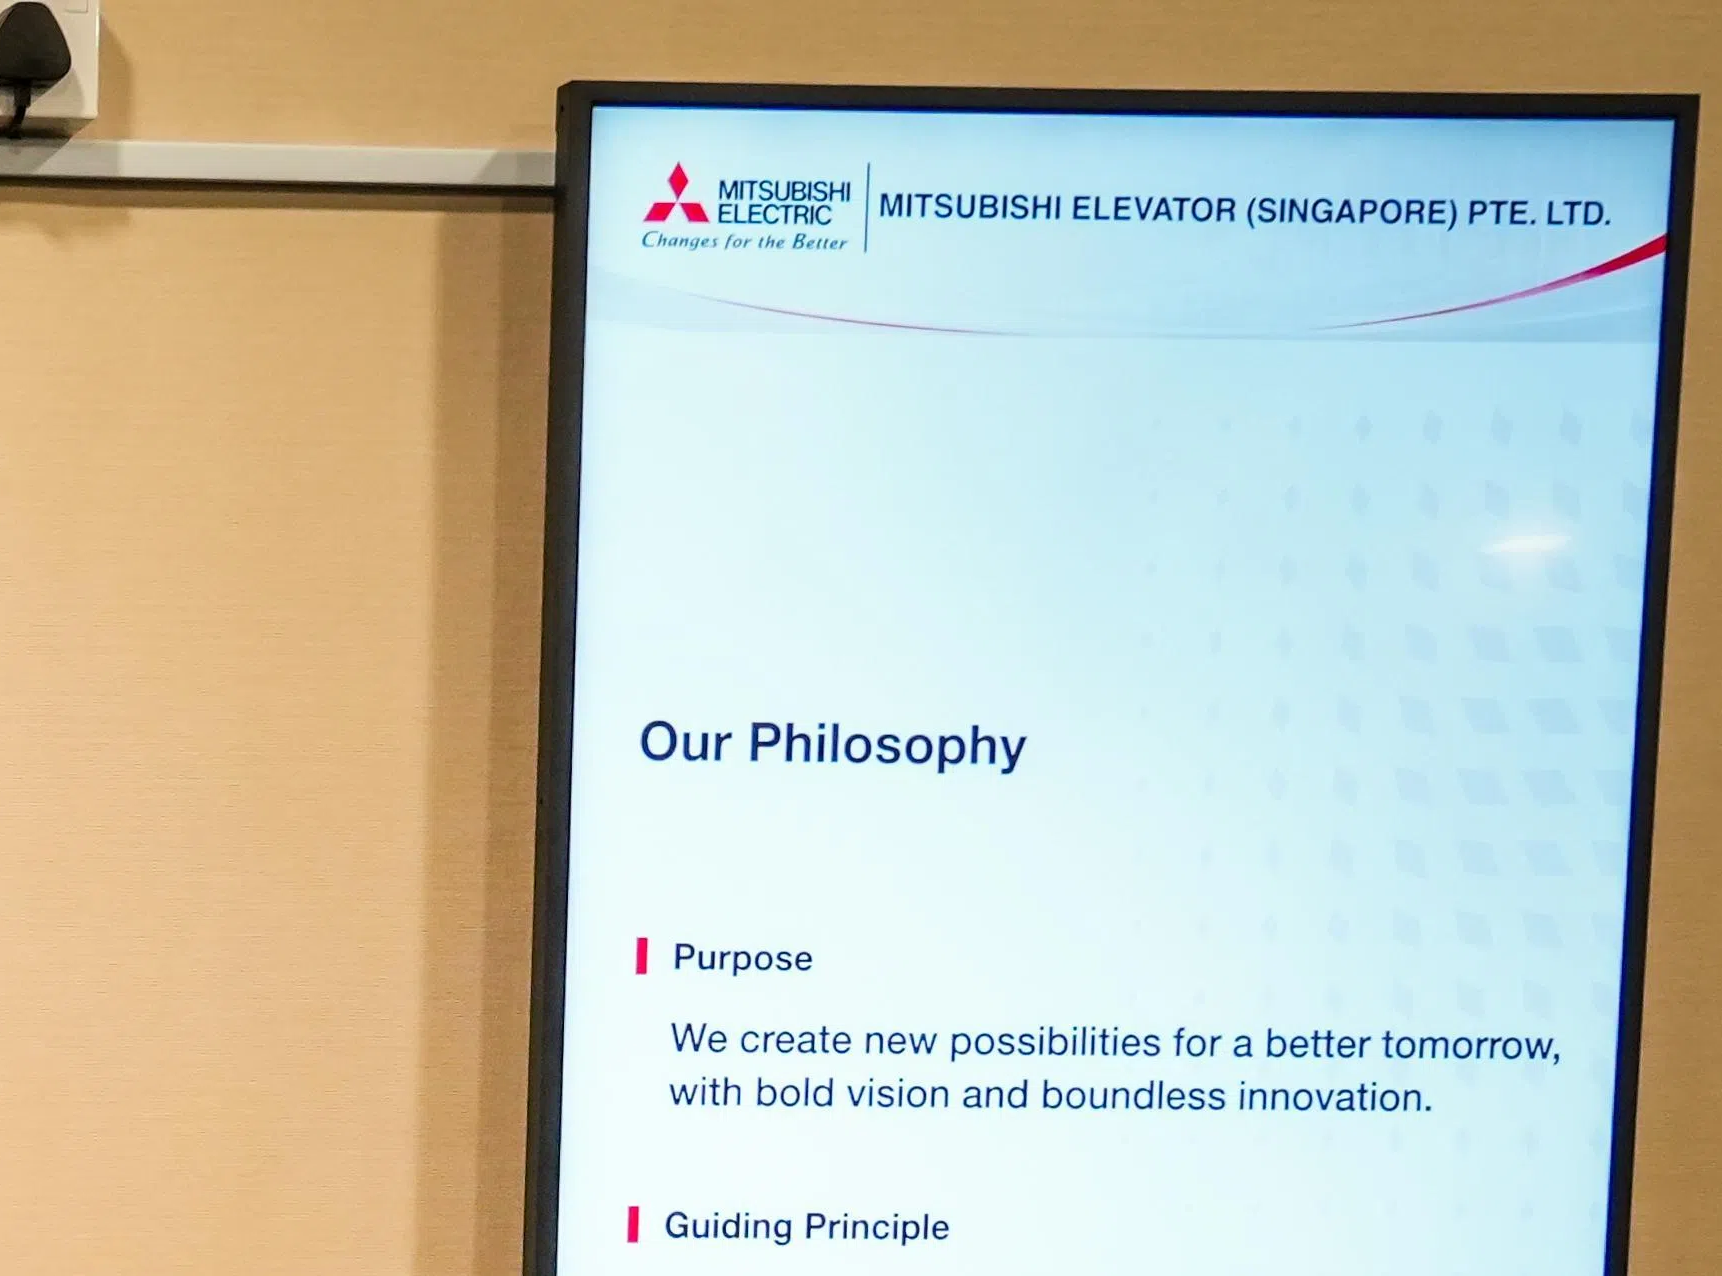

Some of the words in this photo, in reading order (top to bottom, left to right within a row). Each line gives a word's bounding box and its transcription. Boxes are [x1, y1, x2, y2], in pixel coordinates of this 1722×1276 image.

[719, 178, 852, 202] MITSUBISHI
[717, 202, 833, 226] ELECTRIC
[879, 192, 1062, 221] MITSUBISHI
[1072, 195, 1236, 223] ELEVATOR
[1246, 197, 1458, 232] (SINGAPORE)
[1468, 199, 1537, 226] PTE.
[1546, 200, 1611, 227] LTD.
[641, 230, 718, 252] Changes
[724, 233, 753, 251] for
[757, 234, 786, 250] the
[791, 232, 848, 250] Better
[640, 720, 733, 762] Our
[750, 721, 1028, 776] Philosophy
[674, 942, 813, 977] Purpose
[670, 1022, 728, 1054] We
[740, 1025, 852, 1055] create
[865, 1031, 938, 1055] new
[950, 1025, 1161, 1063] possibilities
[1172, 1027, 1223, 1058] for
[1232, 1034, 1254, 1058] a
[1266, 1027, 1372, 1059] better
[1381, 1030, 1560, 1066] tomorrow,
[669, 1076, 742, 1107] with
[756, 1076, 834, 1108] bold
[846, 1077, 949, 1109] vision
[962, 1078, 1029, 1110] and
[1042, 1079, 1226, 1111] boundless
[1239, 1080, 1432, 1113] innovation.
[665, 1211, 792, 1246] Guiding
[805, 1212, 950, 1247] Principle
